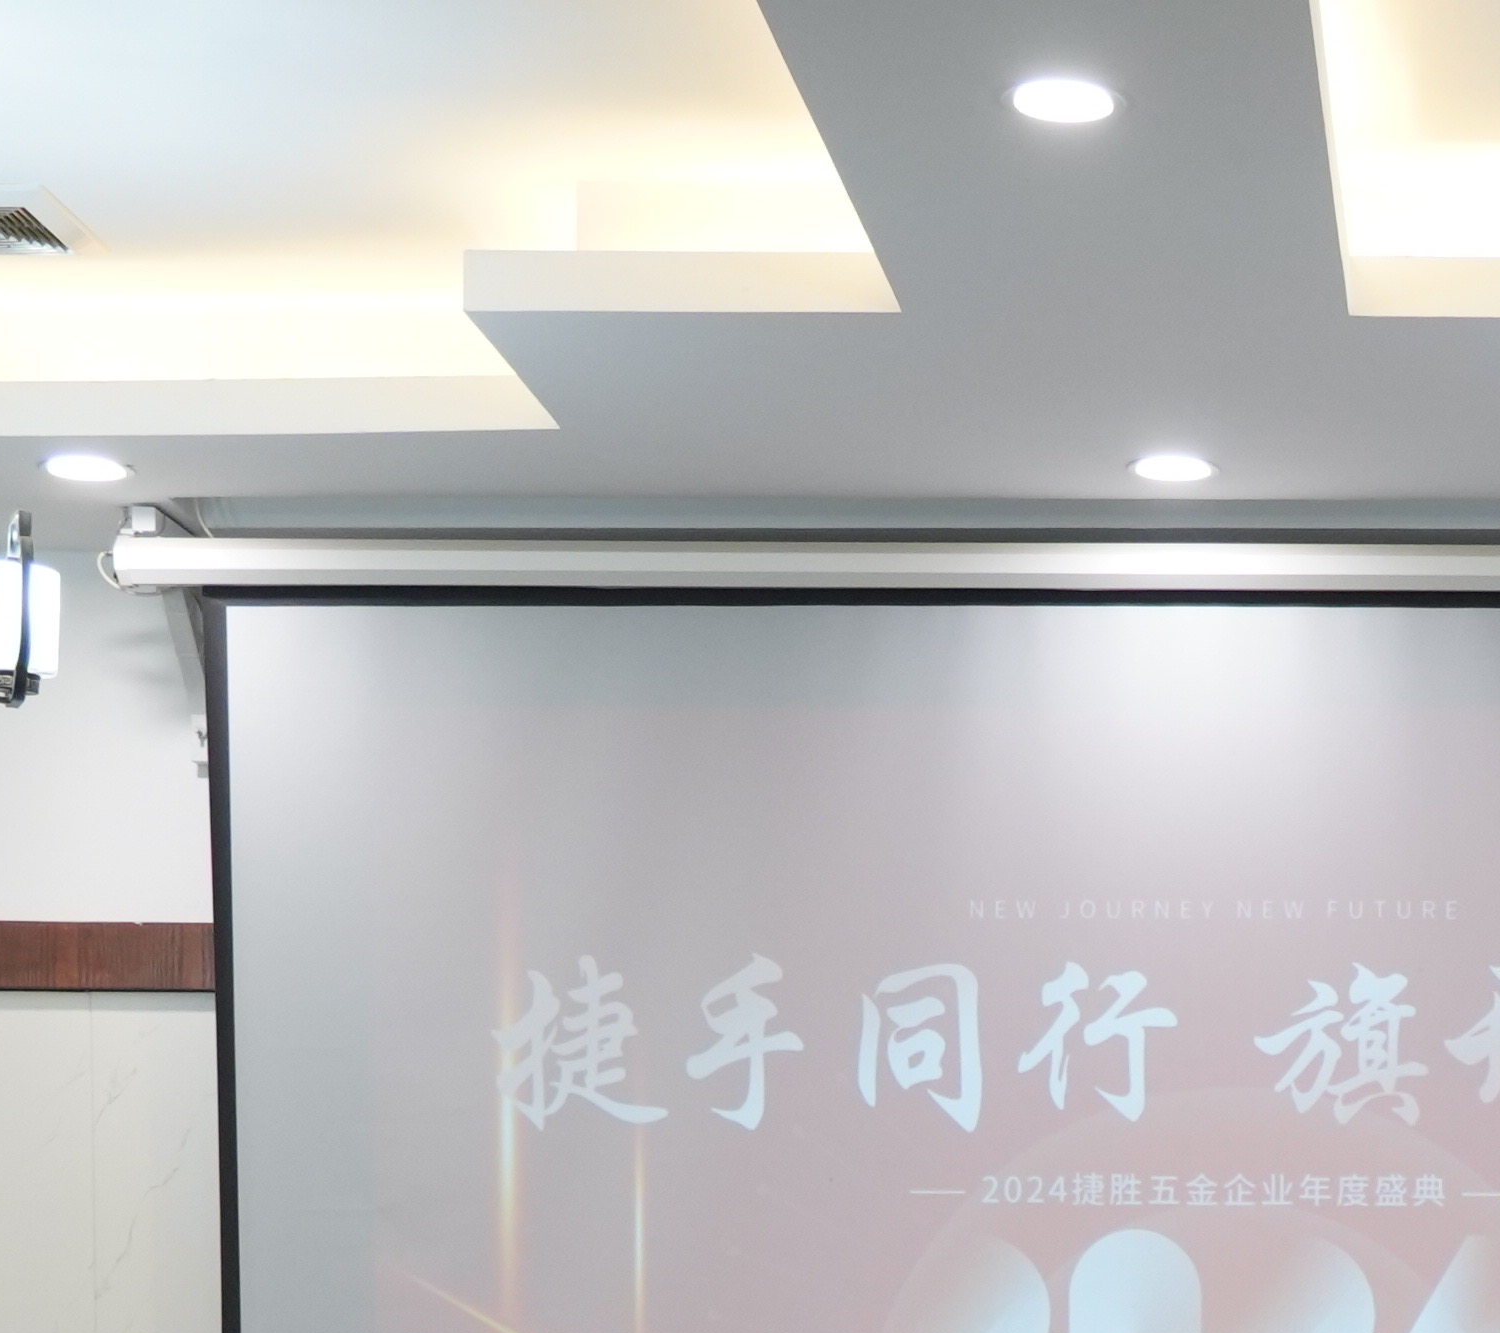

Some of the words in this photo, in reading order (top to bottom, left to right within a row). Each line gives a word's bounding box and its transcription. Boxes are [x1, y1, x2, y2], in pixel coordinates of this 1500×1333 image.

[967, 899, 1038, 920] NEW
[1058, 899, 1216, 920] JOURNEY
[1236, 899, 1305, 920] NEW
[1326, 899, 1460, 920] FUTURE
[490, 951, 1179, 1134] 捷手同行
[980, 1172, 1447, 1208] 2024捷胜五金企业年度盛典
